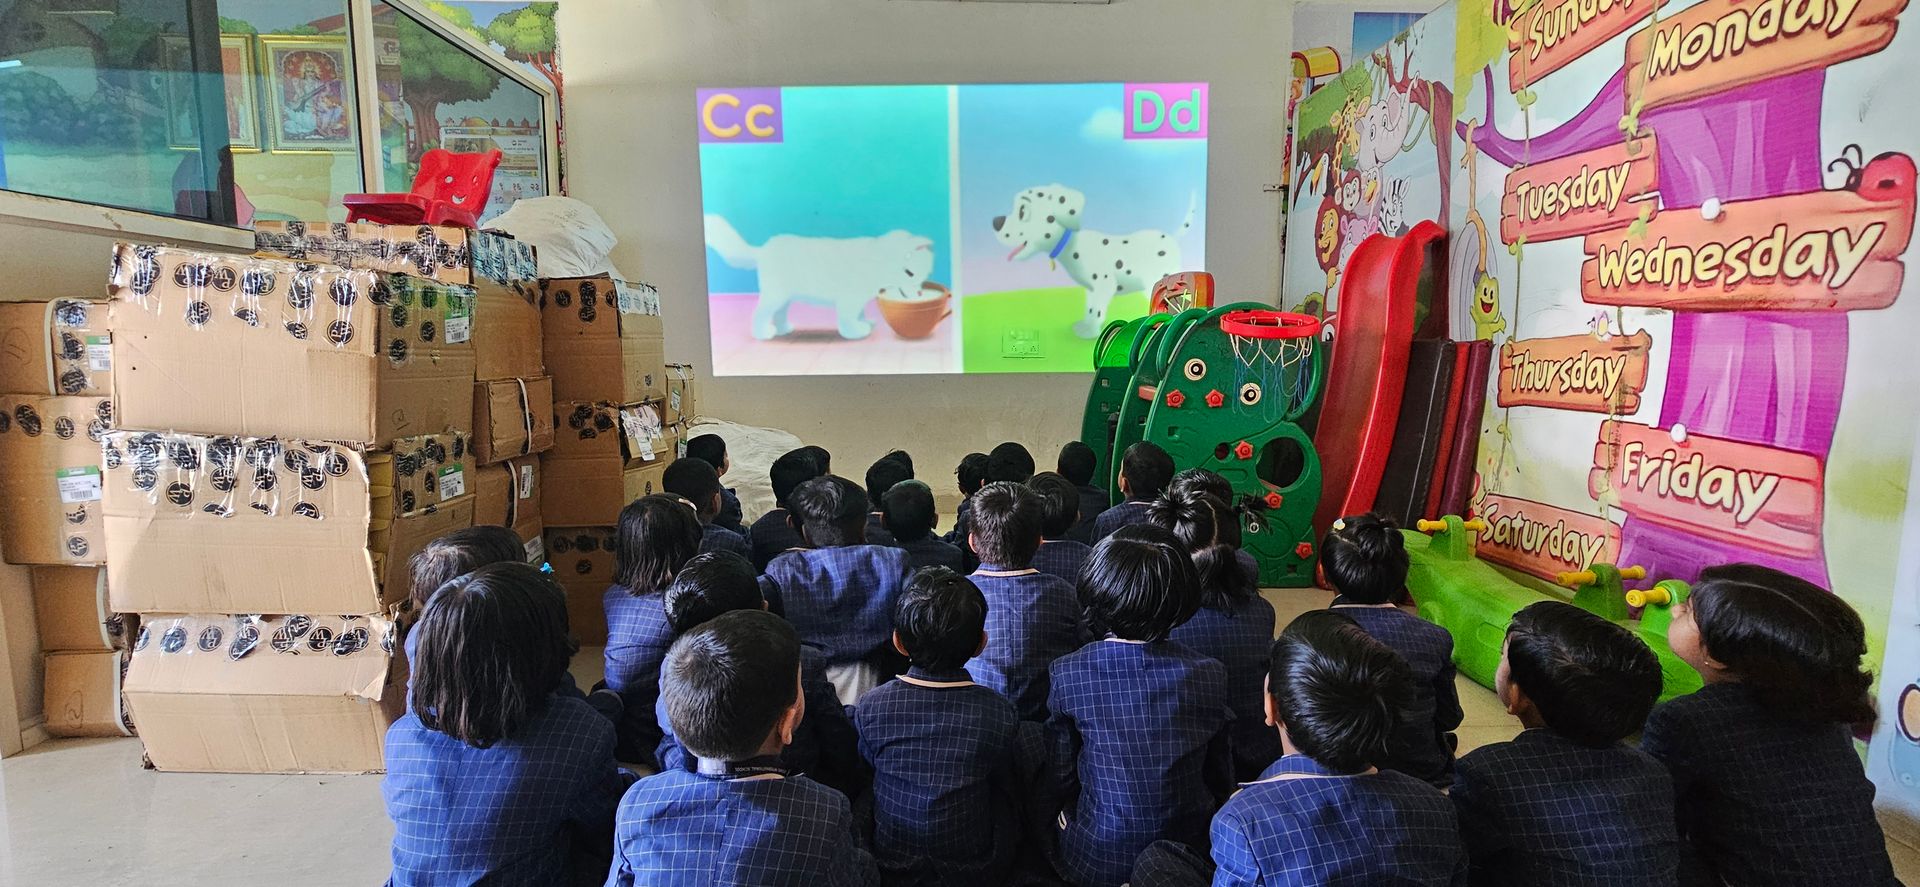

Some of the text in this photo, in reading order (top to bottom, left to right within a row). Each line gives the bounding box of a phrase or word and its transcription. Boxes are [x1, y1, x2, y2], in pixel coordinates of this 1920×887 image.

[702, 93, 775, 138] Cc
[1133, 88, 1200, 133] Dd
[1517, 161, 1631, 223] Tuesday
[1598, 222, 1887, 288] Wednesday
[1512, 349, 1627, 400] Thursday
[1622, 441, 1781, 525] Friday
[1482, 503, 1605, 573] Saturday
